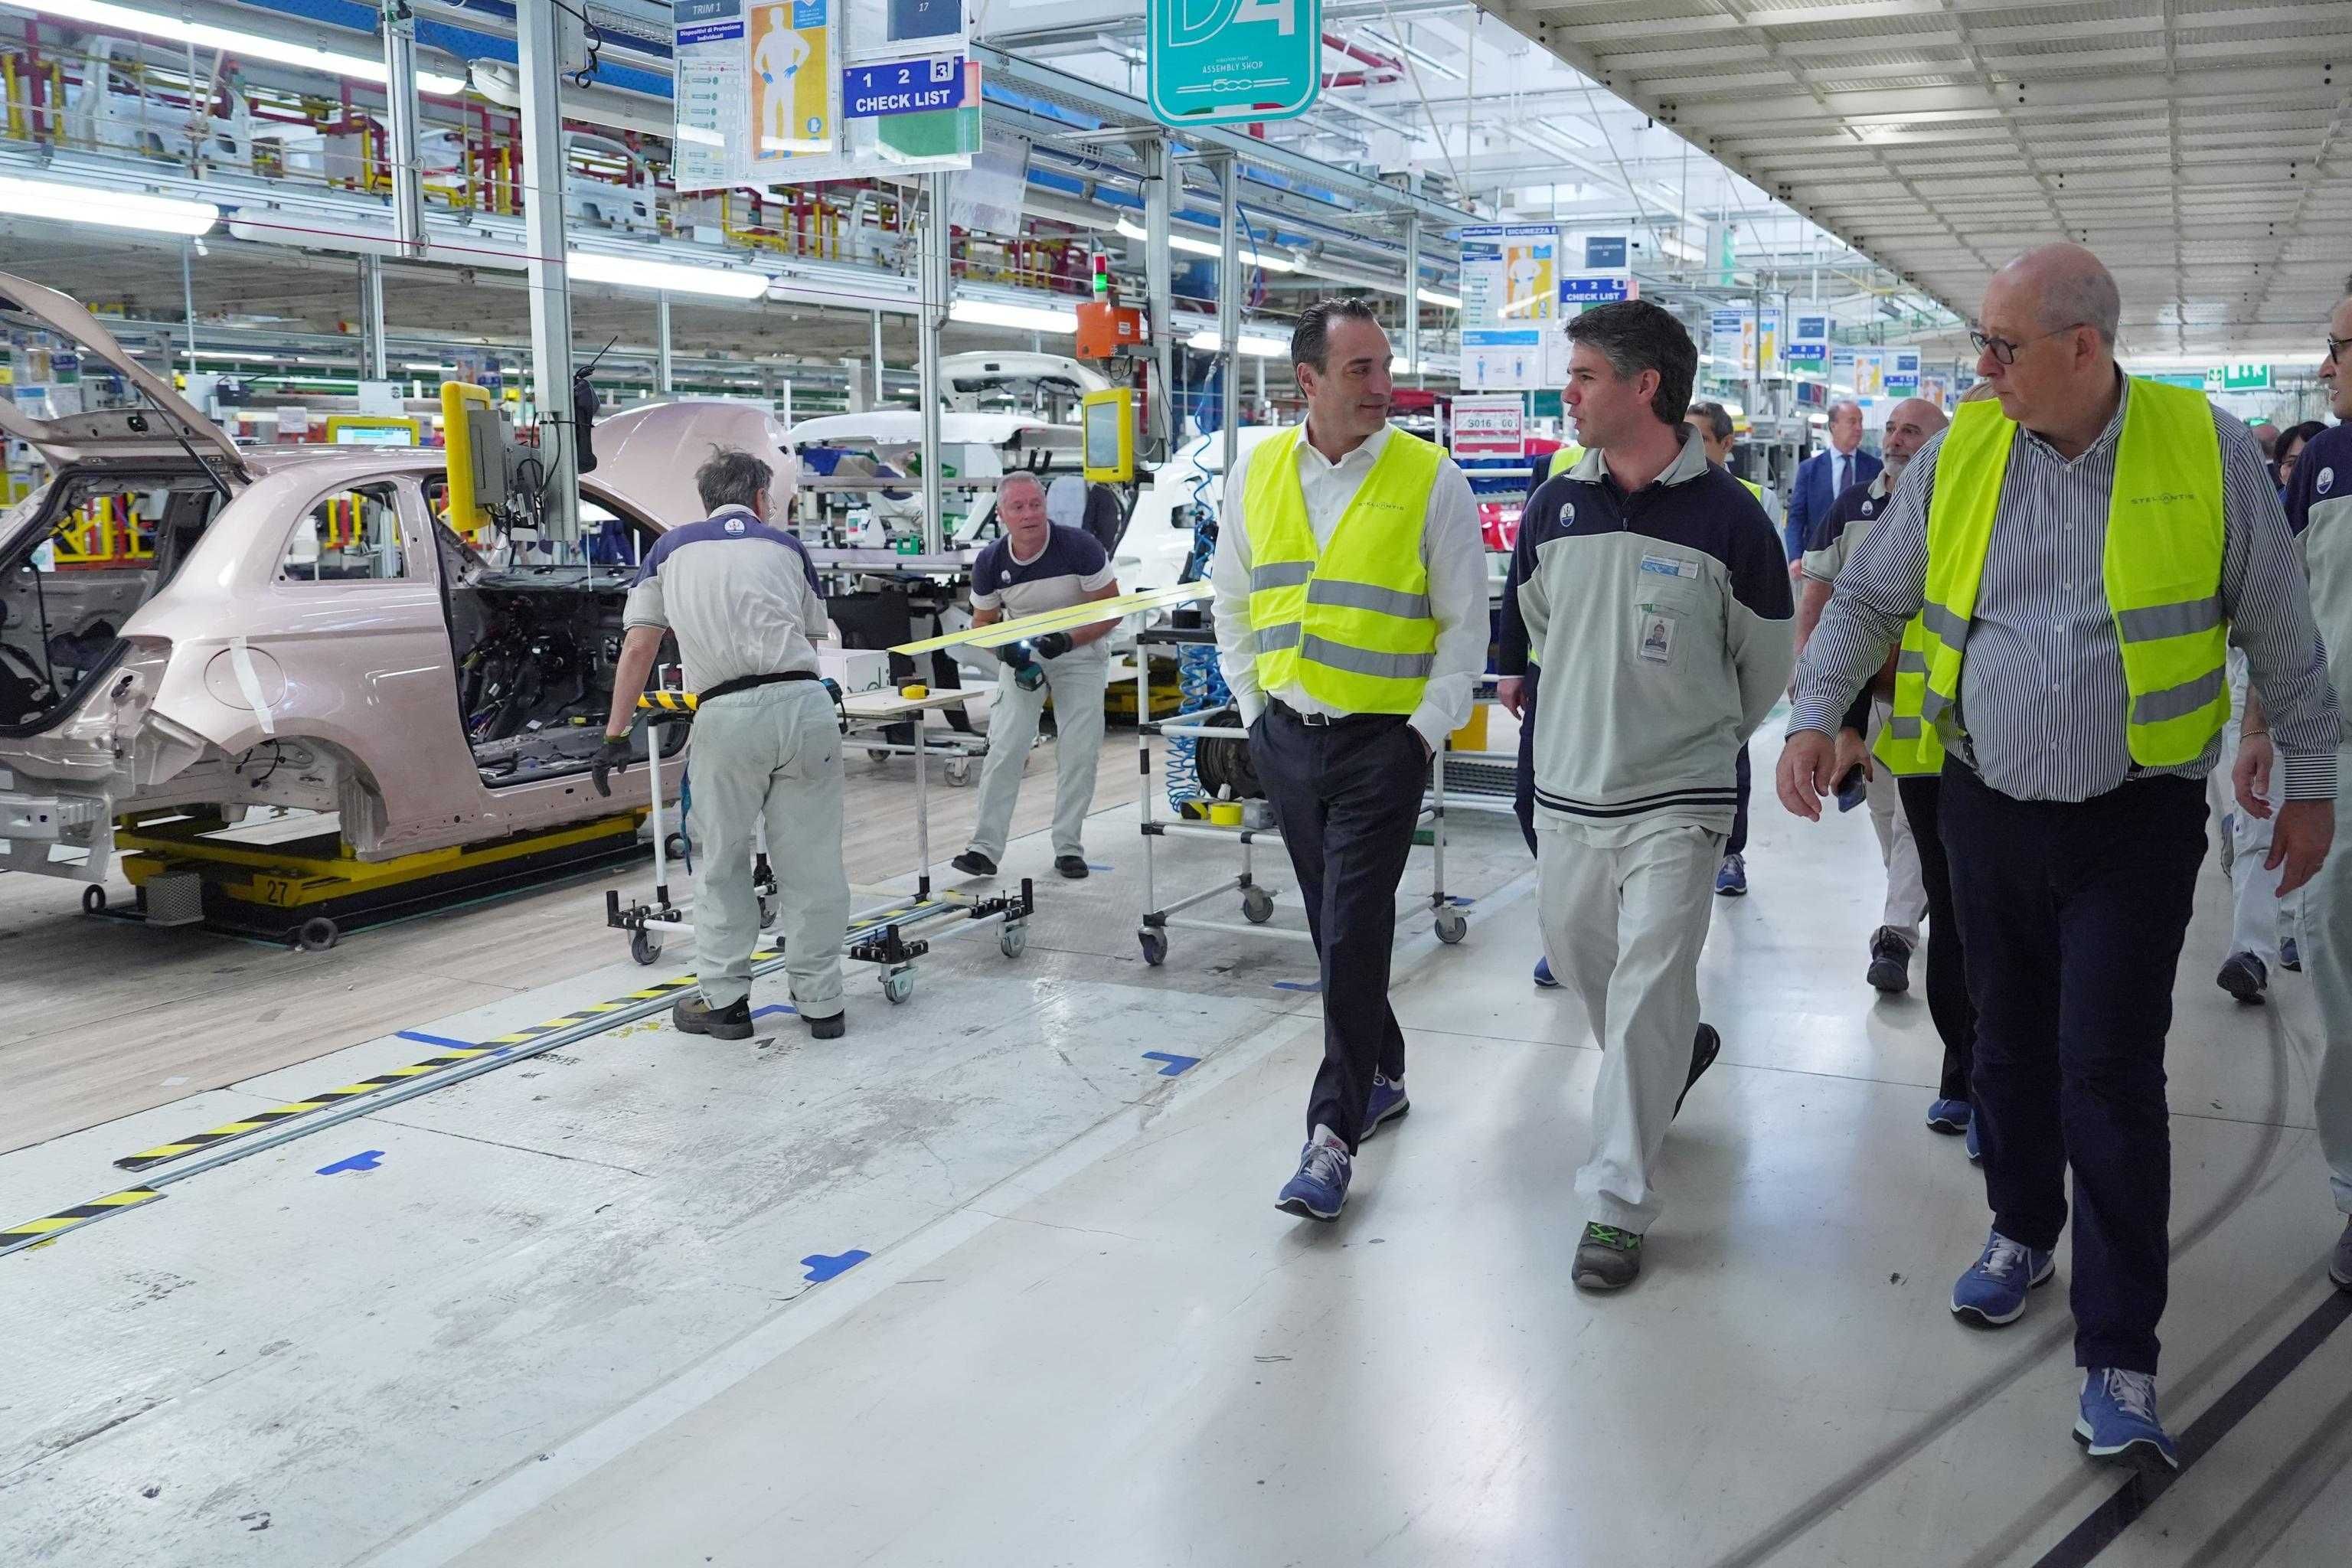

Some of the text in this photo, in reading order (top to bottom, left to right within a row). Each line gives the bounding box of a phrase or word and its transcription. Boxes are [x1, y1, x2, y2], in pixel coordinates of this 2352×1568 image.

[692, 2, 720, 15] TRIM 1
[919, 2, 929, 12] 17
[1202, 61, 1263, 74] ASSEMBLY SHOP
[863, 64, 948, 87] 1 2 3
[1213, 78, 1253, 92] 500
[856, 90, 951, 113] CHECK LIST
[1571, 282, 1577, 290] 1
[1590, 281, 1598, 289] 2
[1566, 292, 1620, 302] CHECK LIST
[267, 880, 289, 905] 27
